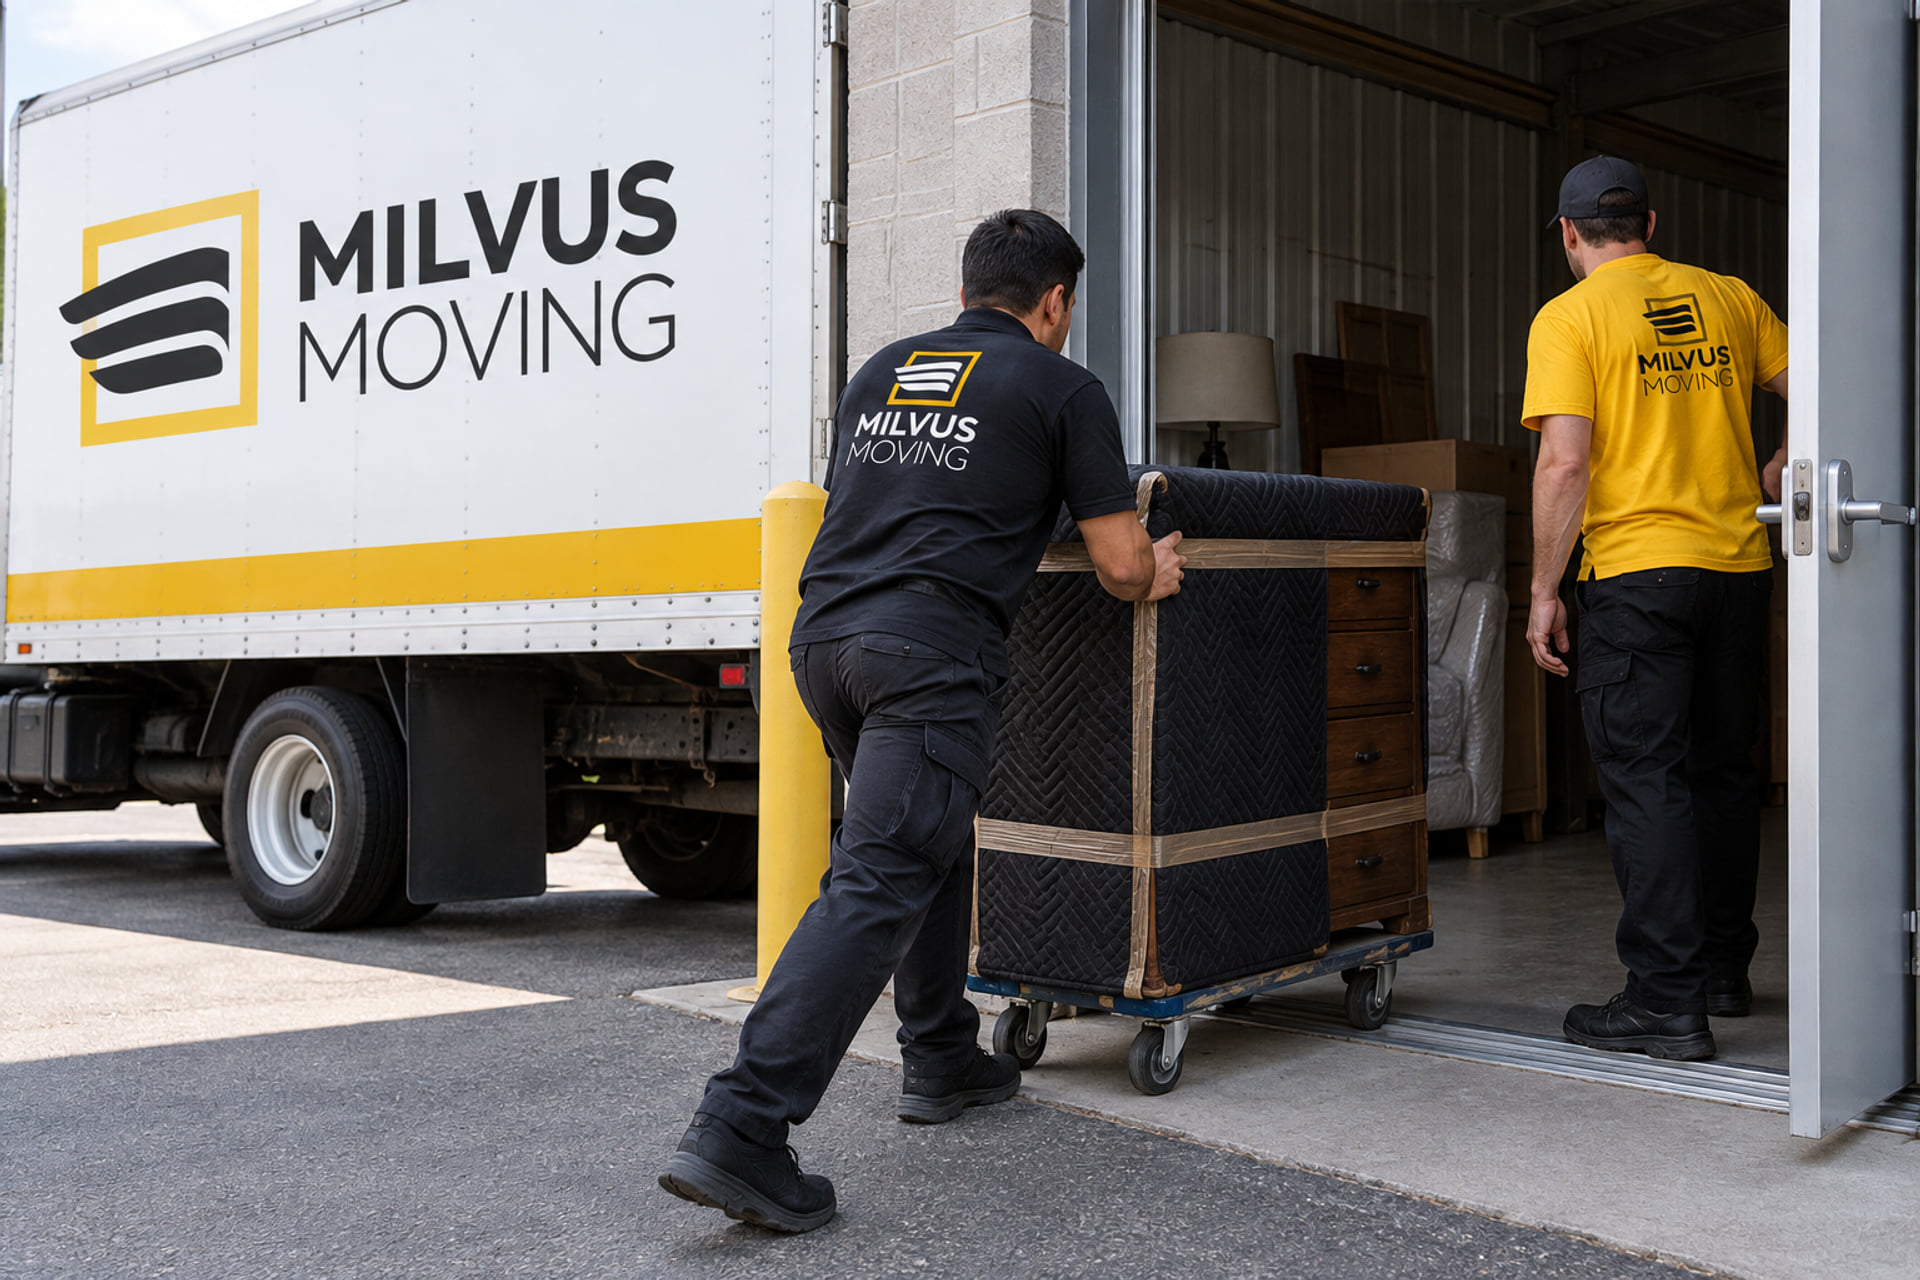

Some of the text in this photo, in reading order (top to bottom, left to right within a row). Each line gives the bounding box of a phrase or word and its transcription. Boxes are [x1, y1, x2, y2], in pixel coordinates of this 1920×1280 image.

[299, 159, 677, 302] MILVUS
[299, 273, 676, 403] MOVING
[1638, 345, 1730, 374] MILVUS
[1643, 368, 1733, 396] MOVING
[854, 411, 979, 443] MILVUS
[845, 439, 970, 471] MOVING
